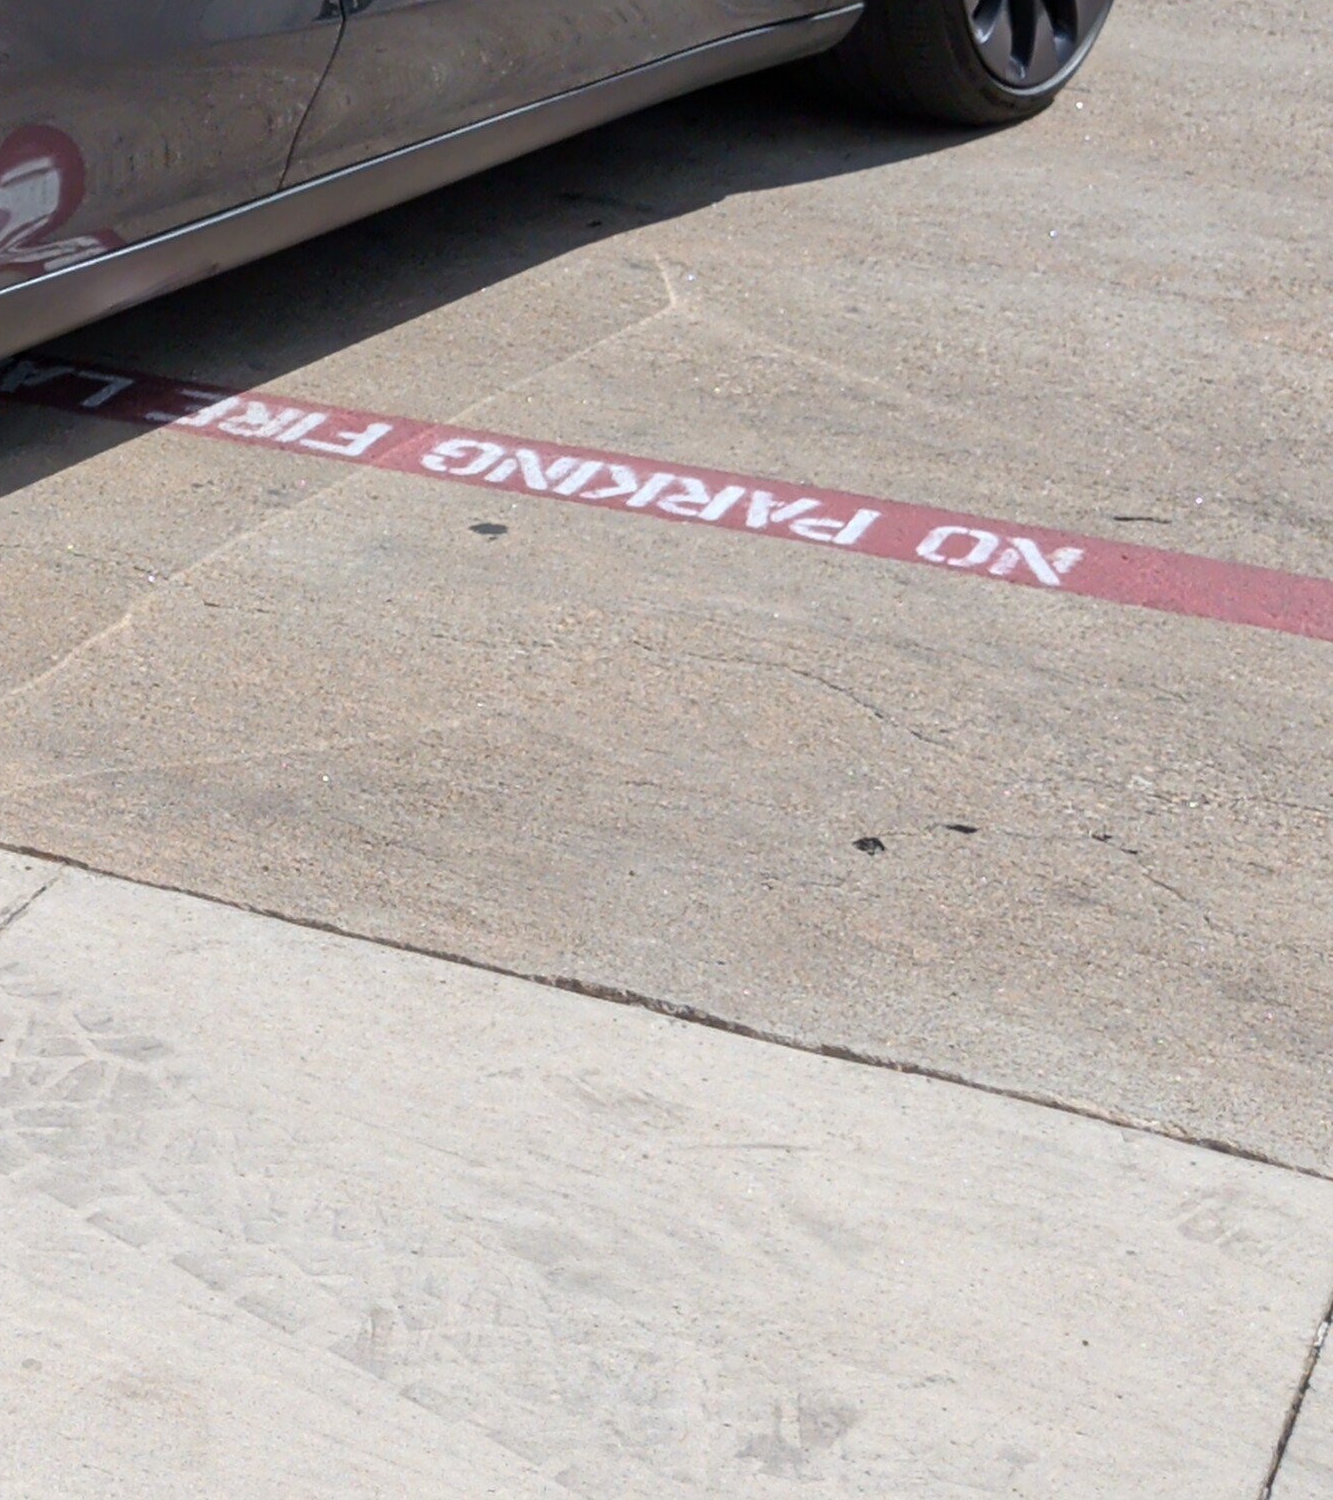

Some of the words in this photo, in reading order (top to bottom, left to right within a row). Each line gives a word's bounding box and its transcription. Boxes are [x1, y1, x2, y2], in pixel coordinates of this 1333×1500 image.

[143, 388, 394, 458] FIRE
[420, 436, 881, 546] PARKING
[915, 525, 1084, 586] NO
